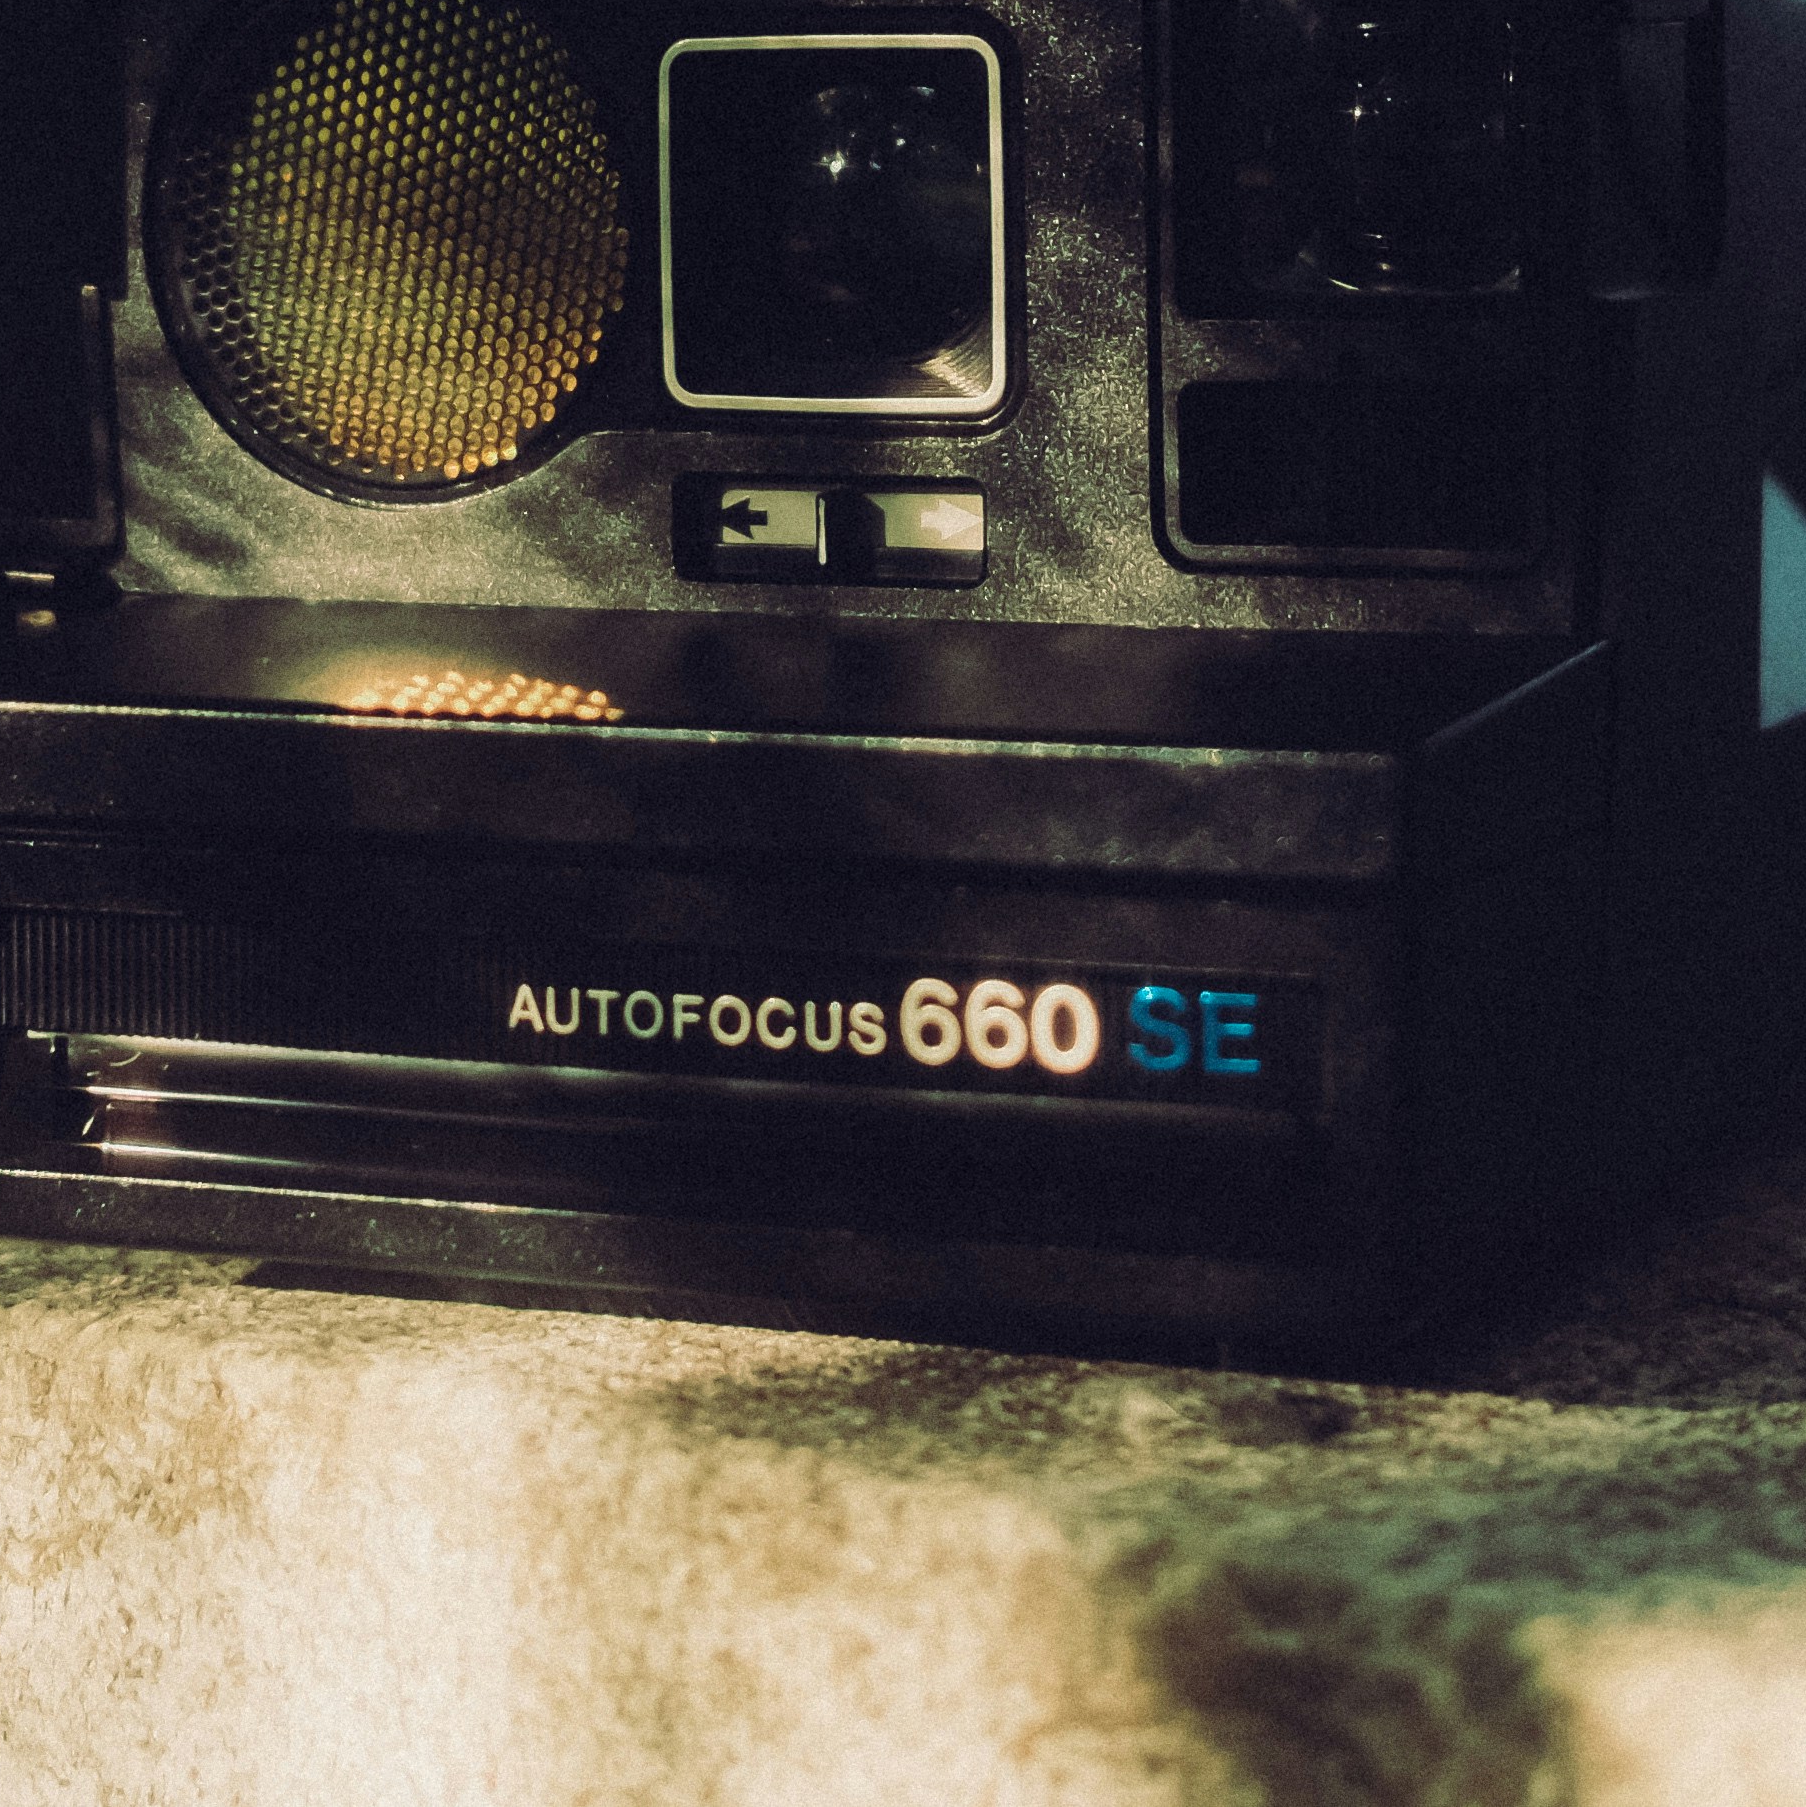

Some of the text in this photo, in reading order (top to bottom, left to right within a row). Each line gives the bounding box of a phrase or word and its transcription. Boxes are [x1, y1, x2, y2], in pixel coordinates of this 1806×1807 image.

[507, 977, 1261, 1075] AUTOFOCUS 660 SE
